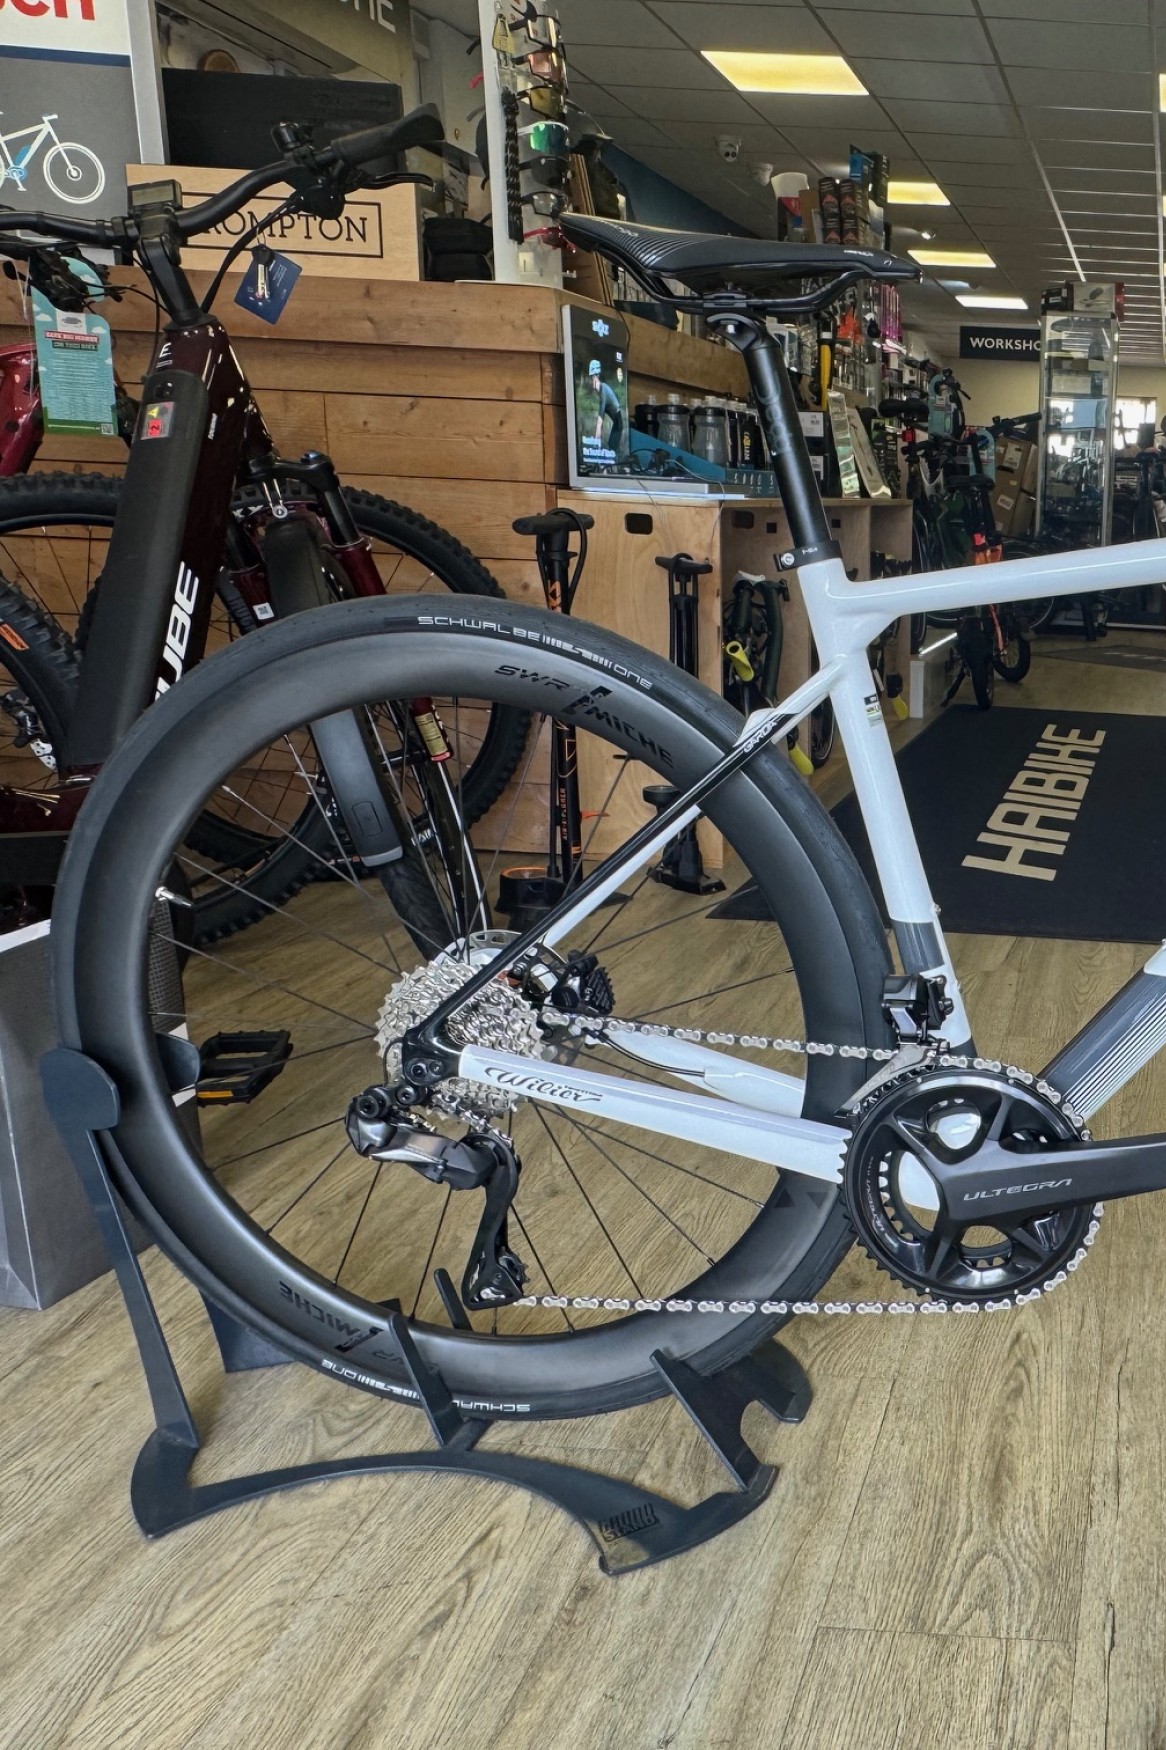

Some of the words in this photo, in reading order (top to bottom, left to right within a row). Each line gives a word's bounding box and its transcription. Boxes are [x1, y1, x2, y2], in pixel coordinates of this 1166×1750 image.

[200, 210, 368, 243] OMPTON
[969, 336, 1041, 352] WORKSHO
[155, 561, 200, 700] UBE
[418, 616, 541, 642] SCHWALBE
[613, 662, 653, 689] ONE
[494, 664, 571, 692] SWR
[584, 706, 675, 770] MICHE
[960, 723, 1108, 882] HAIBIKE
[484, 1066, 604, 1102] Wilier
[963, 1177, 1073, 1202] ULTEGRA
[279, 1280, 361, 1337] MICHE
[451, 1399, 531, 1413] SCHWAL
